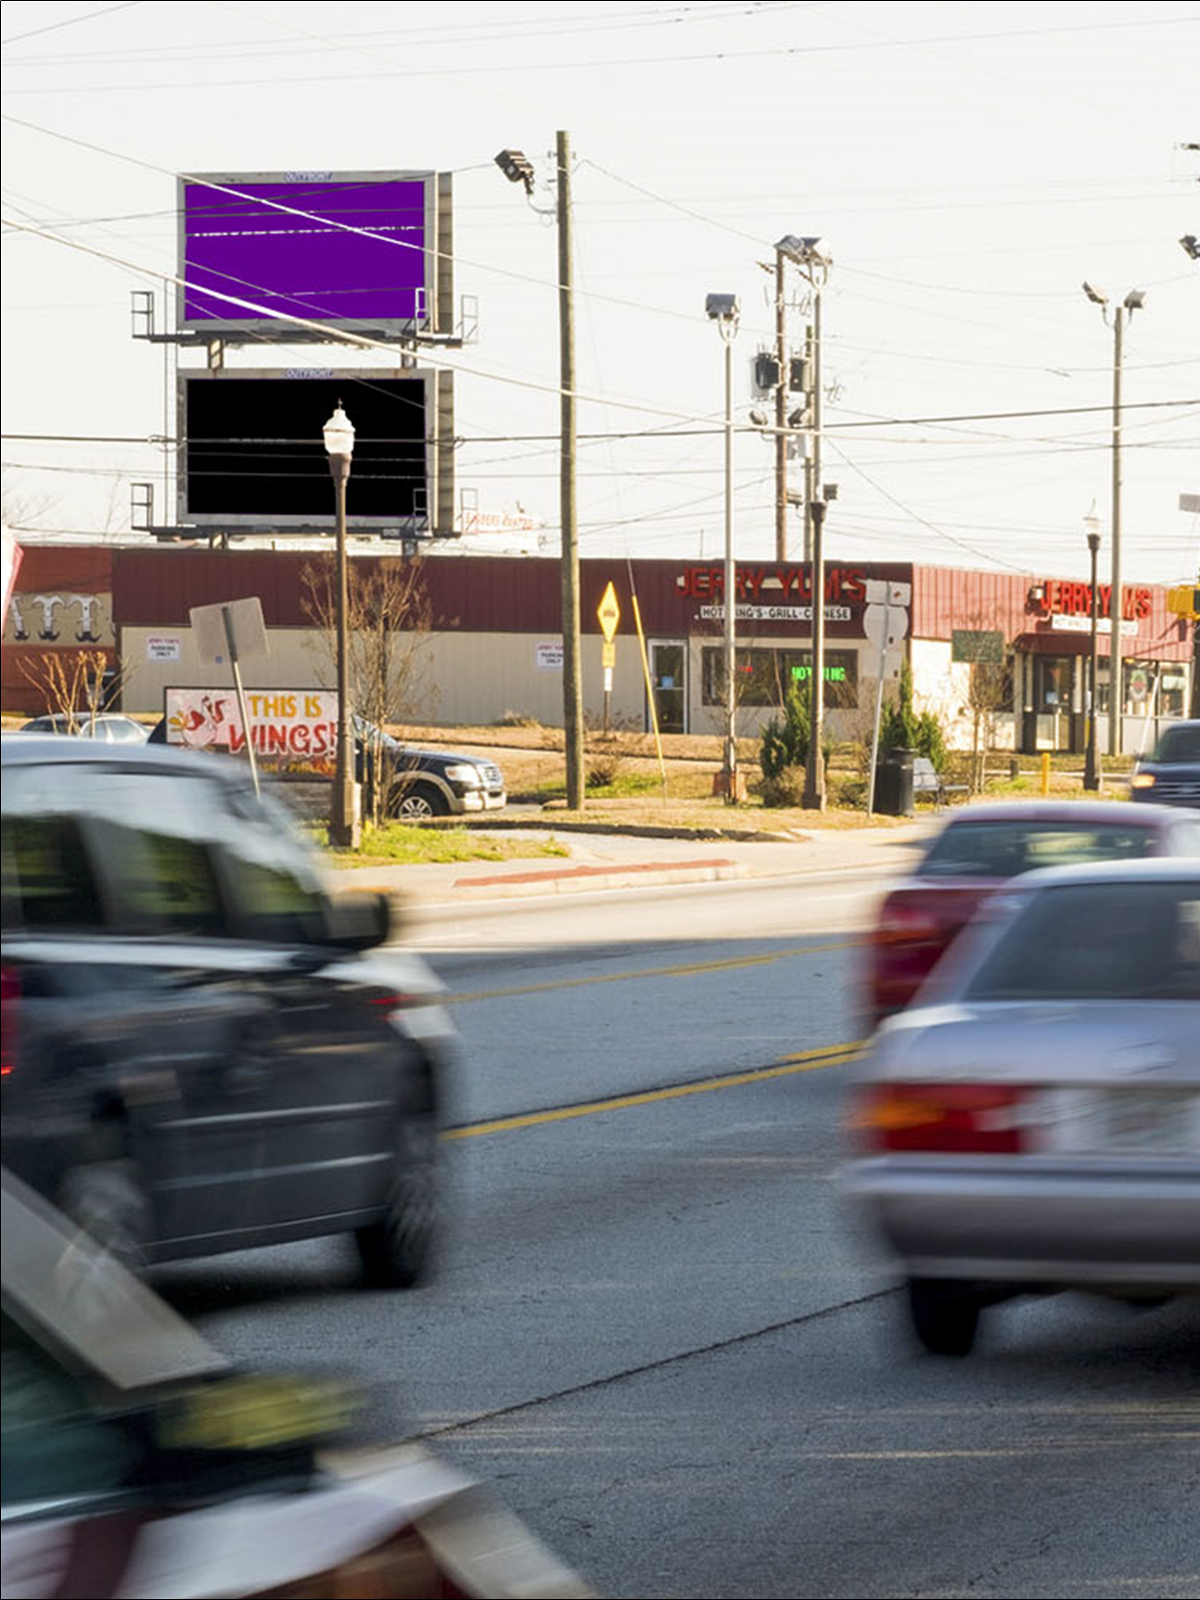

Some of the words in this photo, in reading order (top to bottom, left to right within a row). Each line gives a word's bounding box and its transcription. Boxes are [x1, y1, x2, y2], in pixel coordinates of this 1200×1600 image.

[1040, 580, 1093, 616] JERRY
[1098, 585, 1152, 620] YM'S
[702, 607, 723, 617] HOT
[769, 608, 798, 619] GRILL
[804, 609, 849, 620] CNESE
[791, 666, 812, 680] HOT
[248, 695, 297, 718] THIS
[304, 695, 322, 718] IS
[229, 721, 337, 756] WINGS!
